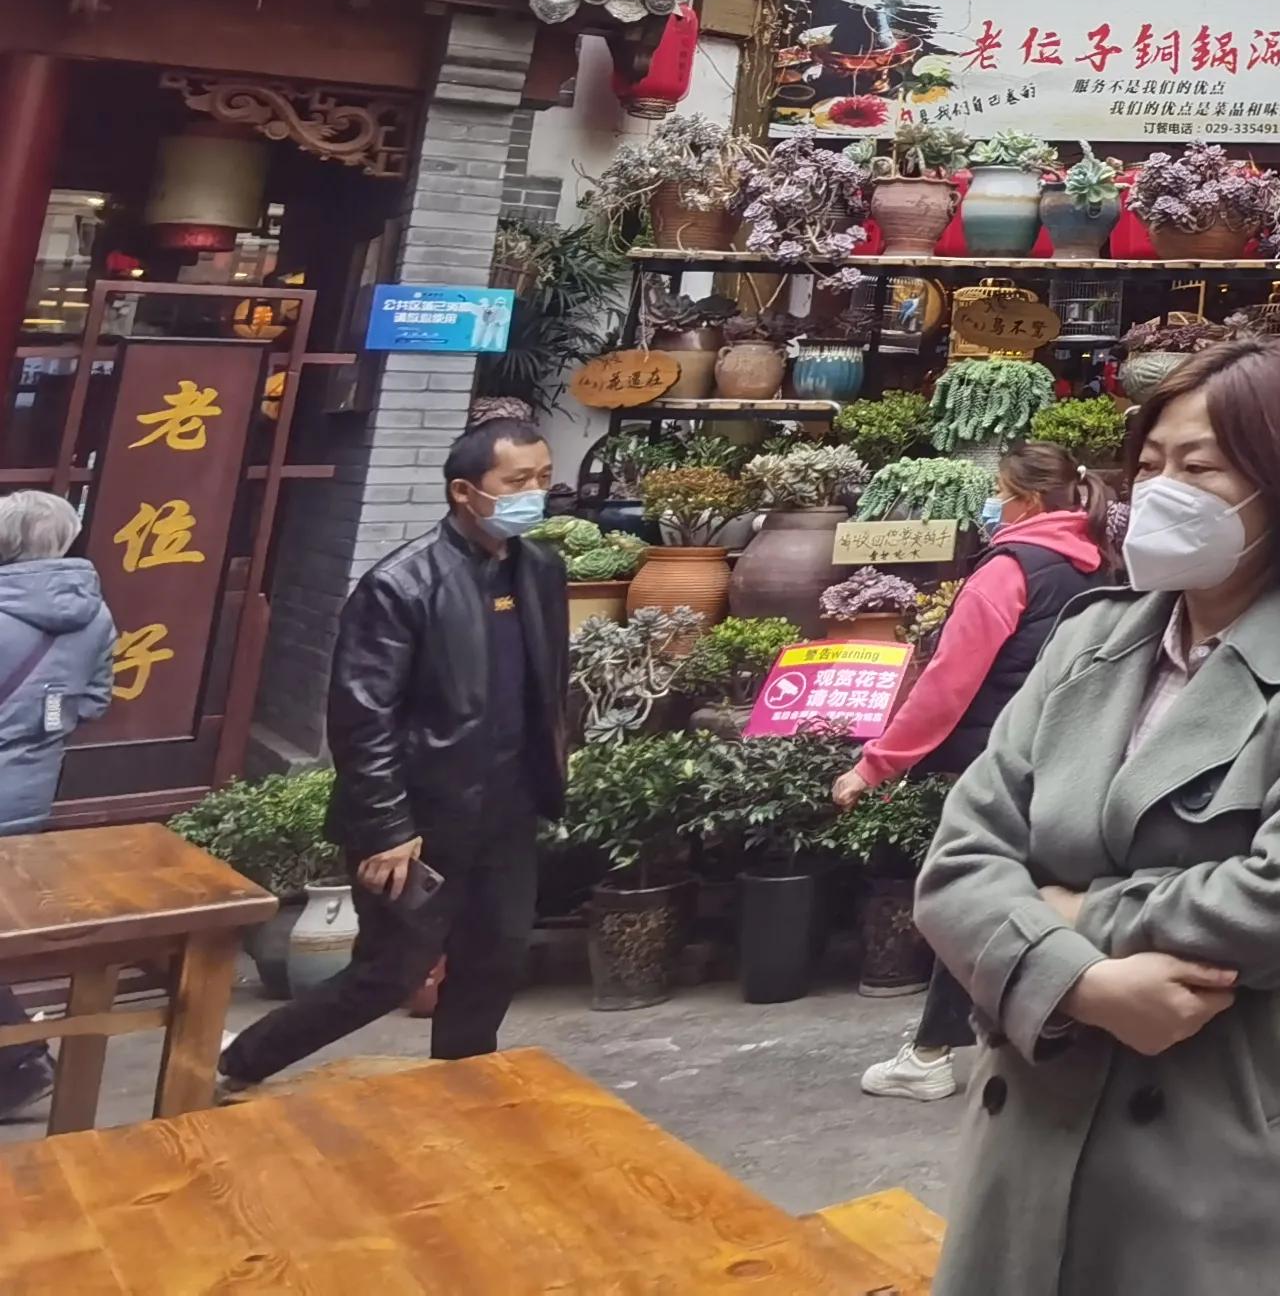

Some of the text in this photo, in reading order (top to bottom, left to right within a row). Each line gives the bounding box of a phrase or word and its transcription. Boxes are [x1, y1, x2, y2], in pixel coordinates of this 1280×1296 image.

[1072, 78, 1227, 95] 服务不是我们的优点
[111, 380, 223, 703] 老位子
[812, 668, 900, 690] 观赏花艺
[805, 689, 893, 710] 请勿采摘
